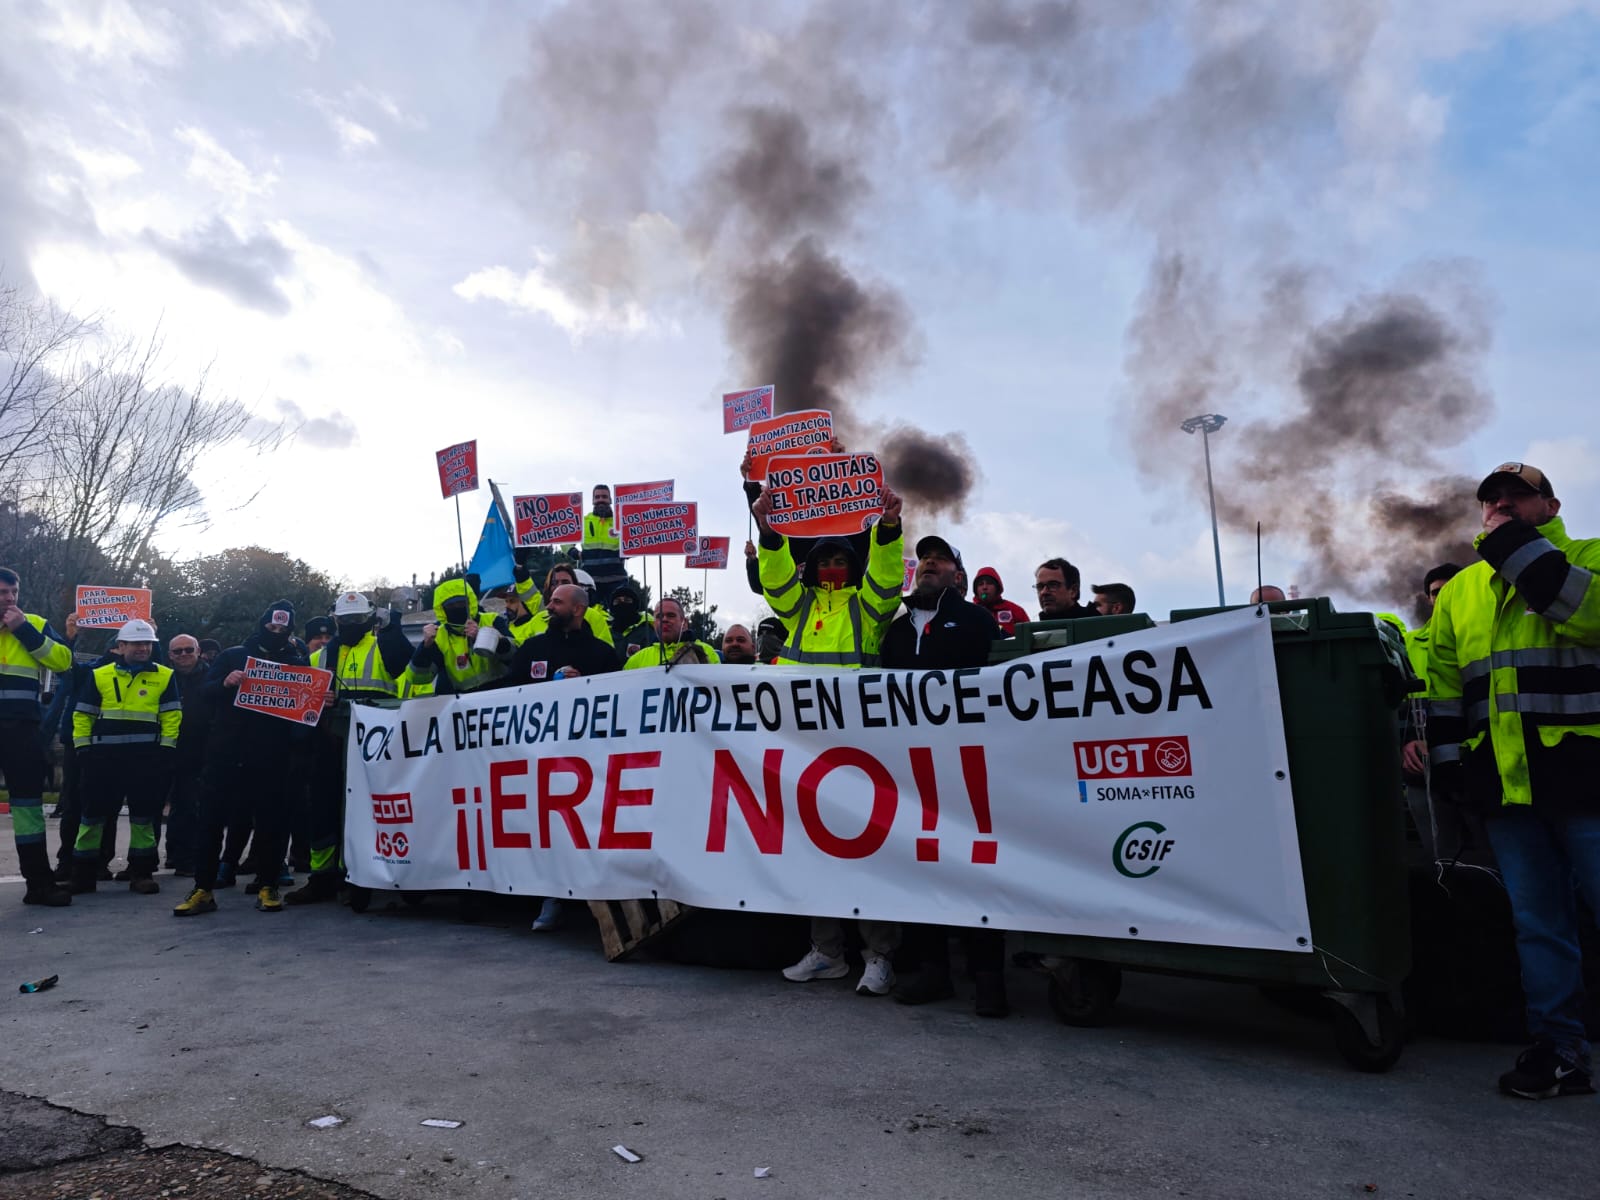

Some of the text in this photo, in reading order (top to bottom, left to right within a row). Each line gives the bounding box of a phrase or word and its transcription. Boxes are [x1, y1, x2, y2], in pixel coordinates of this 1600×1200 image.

[749, 416, 831, 444] AUTOMATIZACIÓN
[751, 430, 830, 456] A LA DIRECCIÓN
[768, 455, 877, 489] NOS QUITÁIS
[771, 479, 881, 510] EL TRABAJO,
[532, 508, 574, 528] SOMOS
[622, 515, 640, 525] LOS
[770, 513, 790, 523] NOS
[792, 505, 825, 521] DEJÁIS
[828, 505, 839, 515] EL
[630, 519, 685, 536] NO LLORAN,
[622, 540, 640, 550] LAS
[642, 531, 685, 546] FAMILIAS
[79, 595, 136, 605] INTELIGENCIA
[84, 590, 107, 598] PARA
[78, 614, 129, 626] GERENCIA
[86, 608, 96, 616] LA
[247, 669, 312, 684] INTELIGENCIA
[251, 684, 289, 695] LA DE LA
[239, 693, 297, 709] GERENCIA
[401, 716, 443, 759] LA
[453, 700, 559, 751] DEFENSA
[568, 694, 628, 741] DEL
[639, 681, 782, 735] EMPLEO
[791, 677, 845, 731] EN
[857, 646, 1213, 728] ENCE-CEASA
[1078, 743, 1149, 775] UGT
[705, 745, 998, 865] NO!!
[1124, 839, 1175, 861] CSIF
